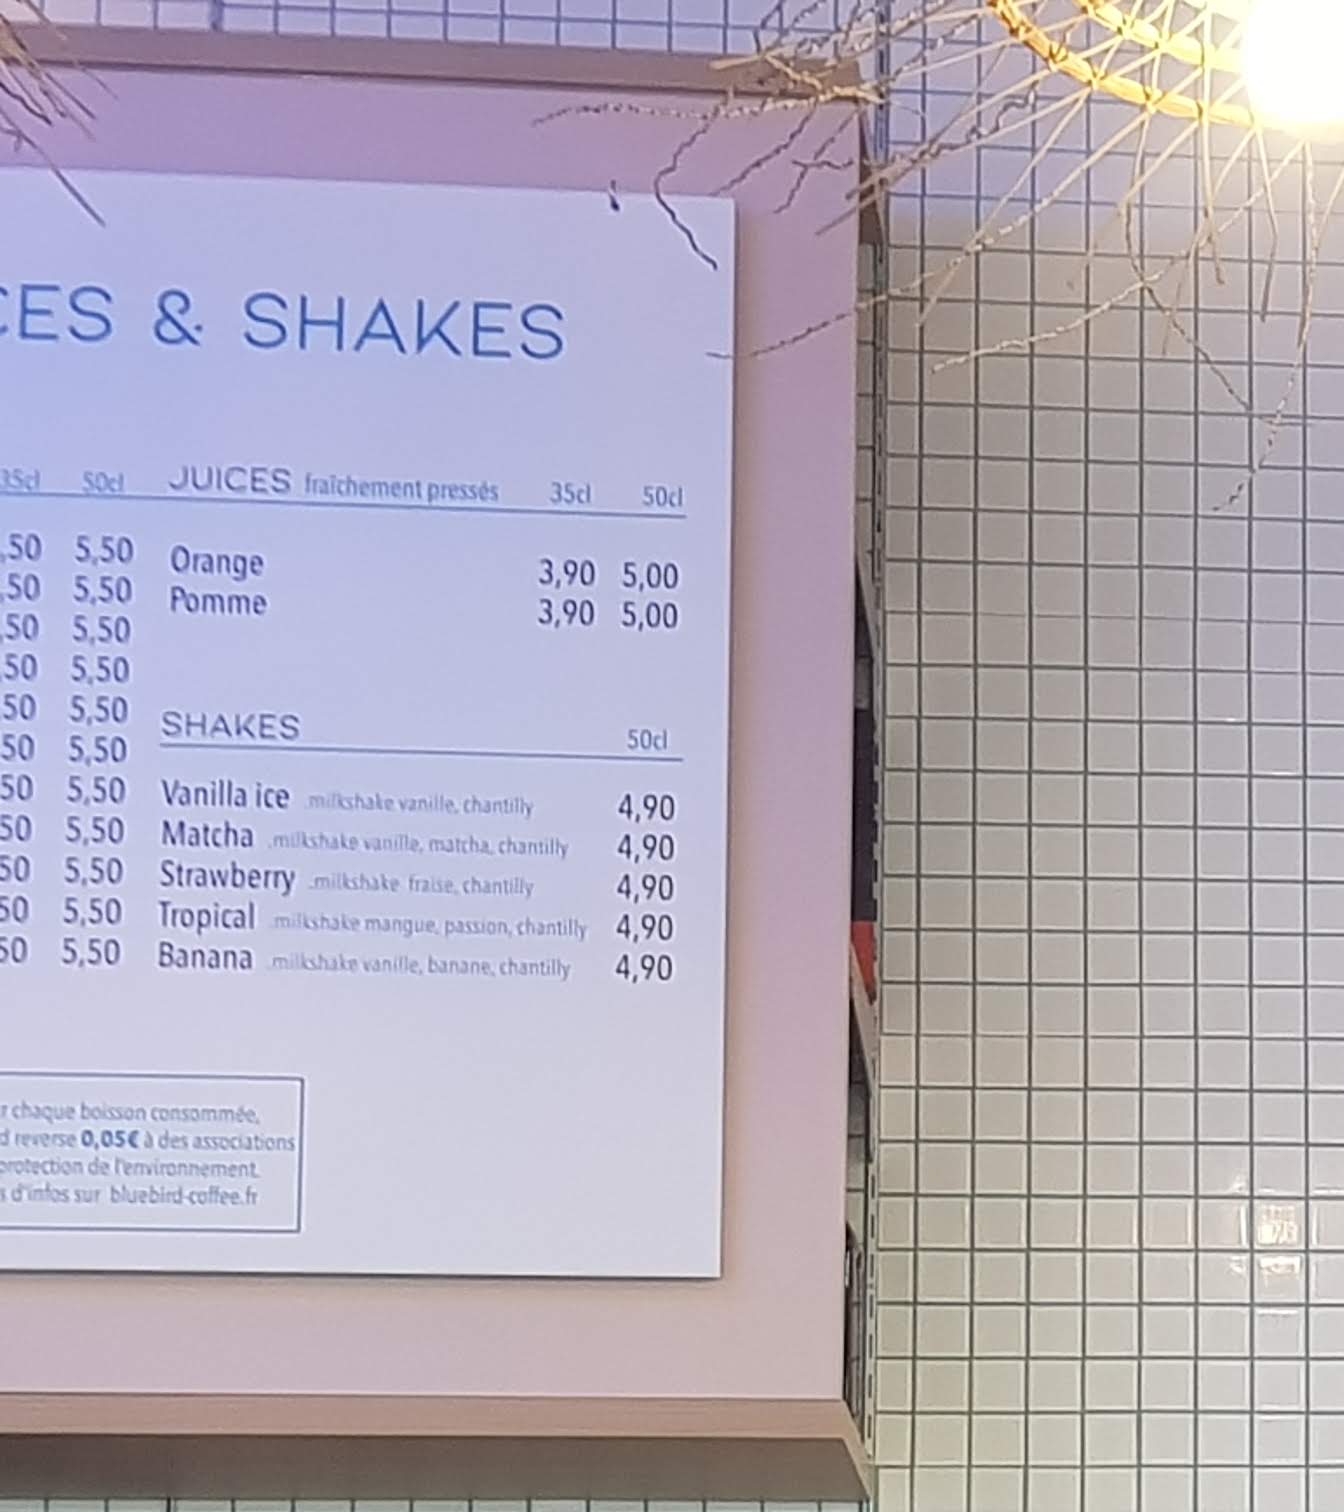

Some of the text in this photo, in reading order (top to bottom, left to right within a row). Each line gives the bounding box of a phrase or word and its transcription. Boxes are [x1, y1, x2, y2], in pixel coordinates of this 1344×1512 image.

[153, 289, 203, 346] &
[243, 292, 564, 359] SHAKES
[83, 471, 124, 492] 50cl
[169, 466, 499, 504] JUICES fraîchement pressés
[550, 482, 683, 508] 35cl 50cl
[75, 533, 134, 566] 5,50
[170, 545, 679, 593] Orange 3,90 5,00
[73, 575, 132, 605] 5,50
[170, 585, 678, 632] Pomme 3,90 5,00
[72, 614, 131, 645] 5,50
[71, 655, 130, 685] 5,50
[70, 695, 128, 726] 5,50
[161, 711, 669, 752] SHAKES 50cl
[68, 735, 127, 766] 5,50
[67, 776, 126, 807] 5,50
[161, 779, 248, 808] Vanilla
[256, 782, 290, 809] ice
[463, 796, 534, 819] chantilly
[617, 793, 676, 823] 4,90
[66, 816, 124, 847] 5,50
[161, 820, 254, 848] Matcha
[428, 835, 493, 856] matcha,
[498, 836, 569, 860] chantilly
[617, 833, 675, 864] 4,90
[64, 857, 123, 887] 5,50
[160, 859, 296, 897] Strawberry
[463, 876, 534, 899] chantilly
[616, 873, 674, 904] 4,90
[63, 897, 122, 927] 5,50
[158, 900, 255, 935] Tropical
[517, 918, 588, 942] chantilly
[616, 914, 673, 943] 4,90
[62, 937, 121, 968] 5,50
[158, 941, 253, 970] Banana
[500, 958, 571, 982] chantilly
[615, 954, 673, 984] 4,90
[11, 1101, 75, 1124] chaque
[80, 1102, 147, 1121] boisson
[15, 1132, 77, 1148] reverse
[80, 1130, 140, 1150] 0,05€
[158, 1131, 188, 1151] des
[192, 1134, 296, 1152] associations
[87, 1157, 110, 1177] de
[73, 1187, 101, 1204] sur
